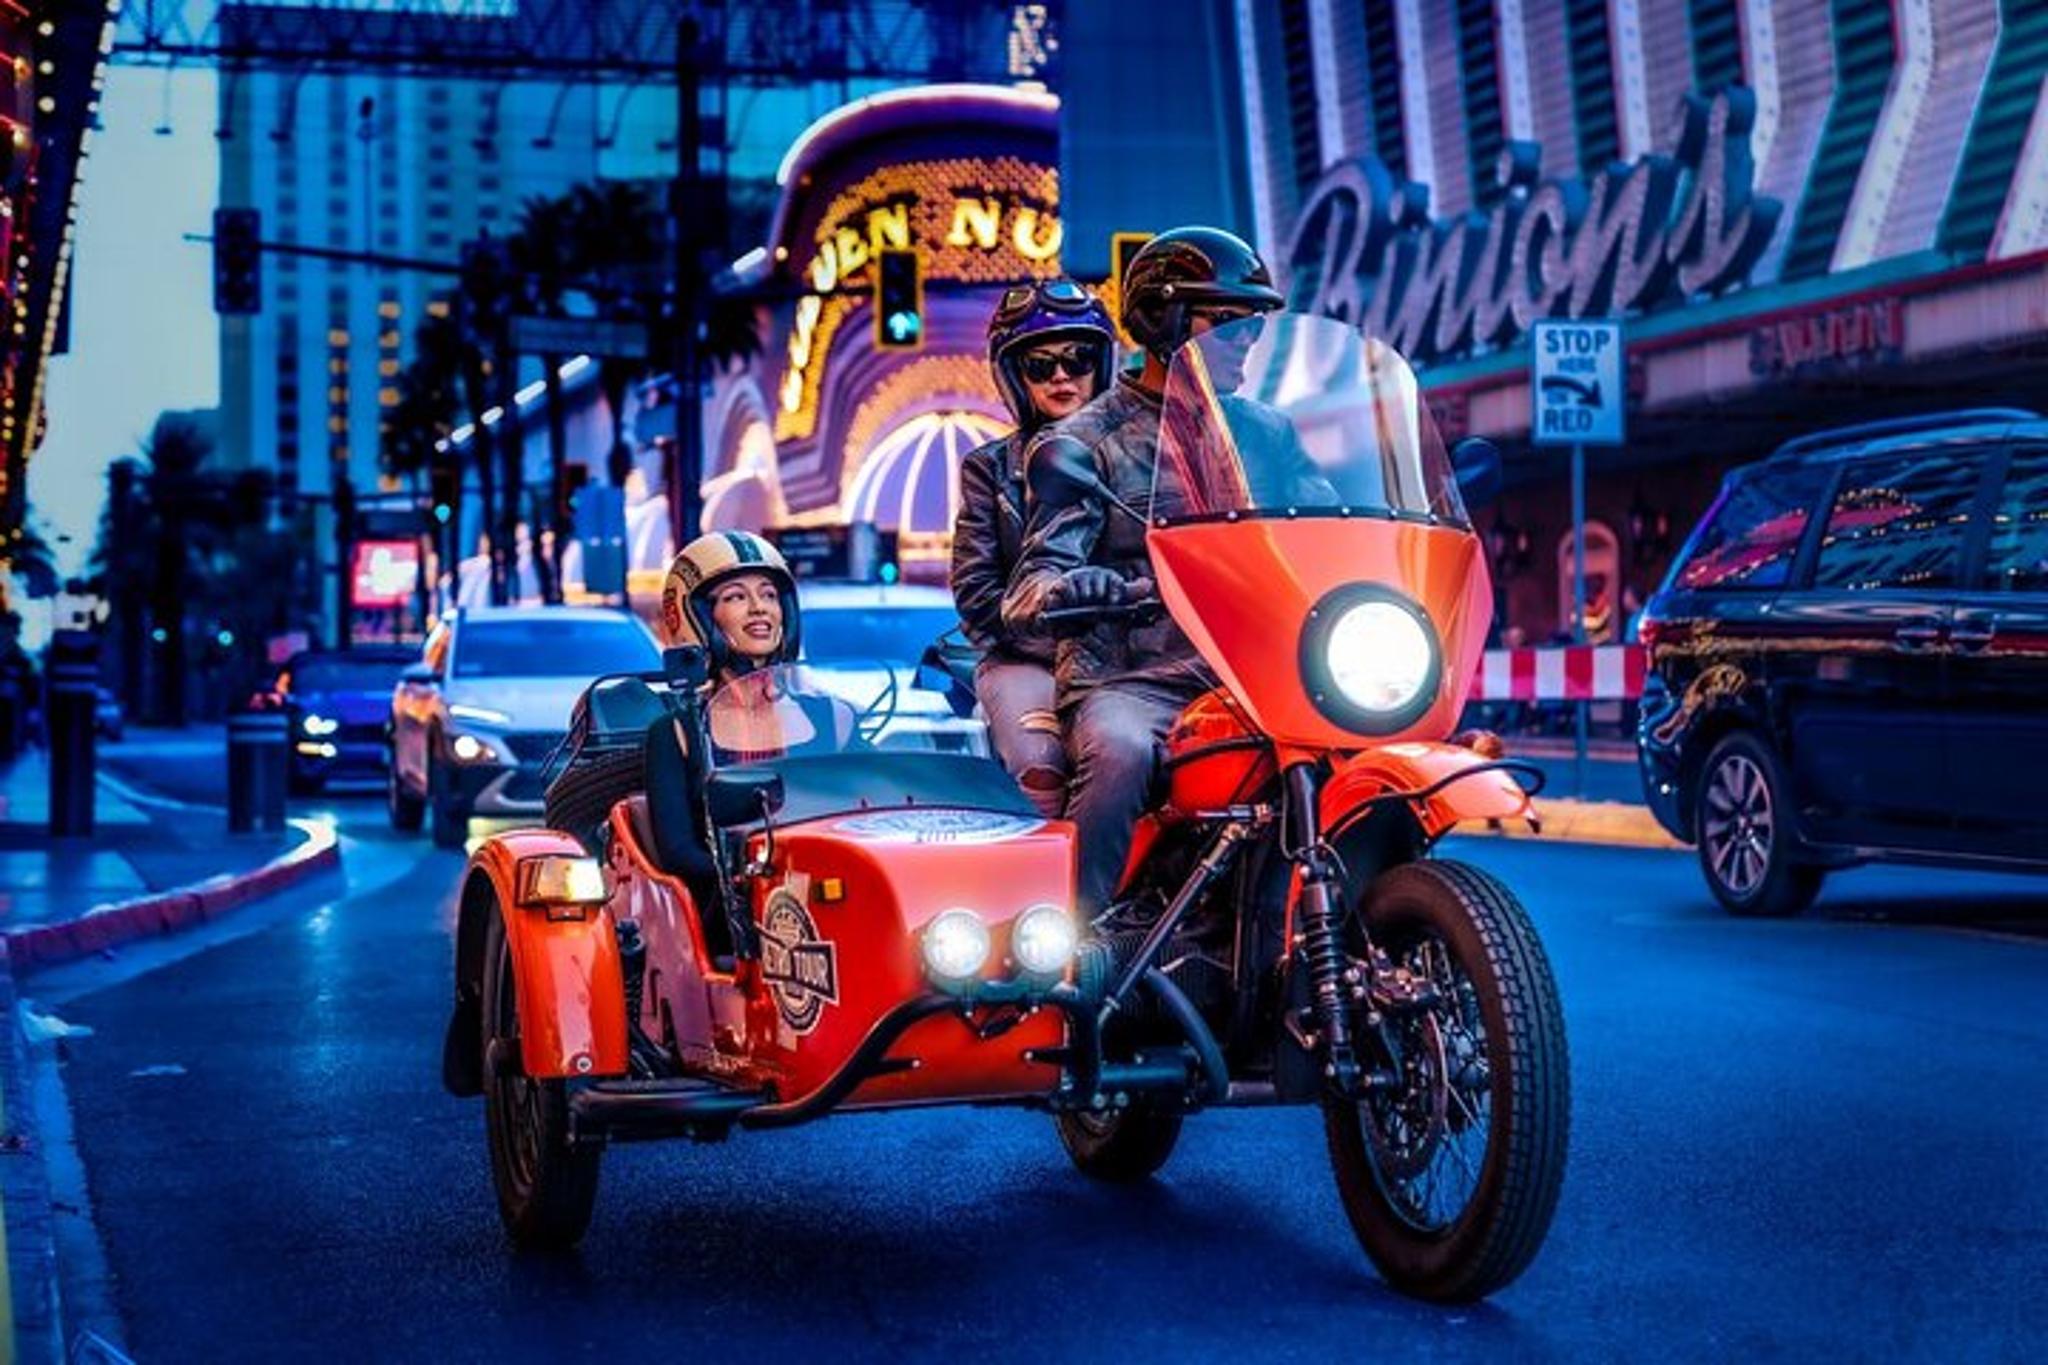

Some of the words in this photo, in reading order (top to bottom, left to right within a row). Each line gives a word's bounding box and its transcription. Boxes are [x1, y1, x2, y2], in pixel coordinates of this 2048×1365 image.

[1545, 329, 1611, 354] STOP
[1557, 357, 1597, 374] HERE
[1543, 408, 1594, 434] RED
